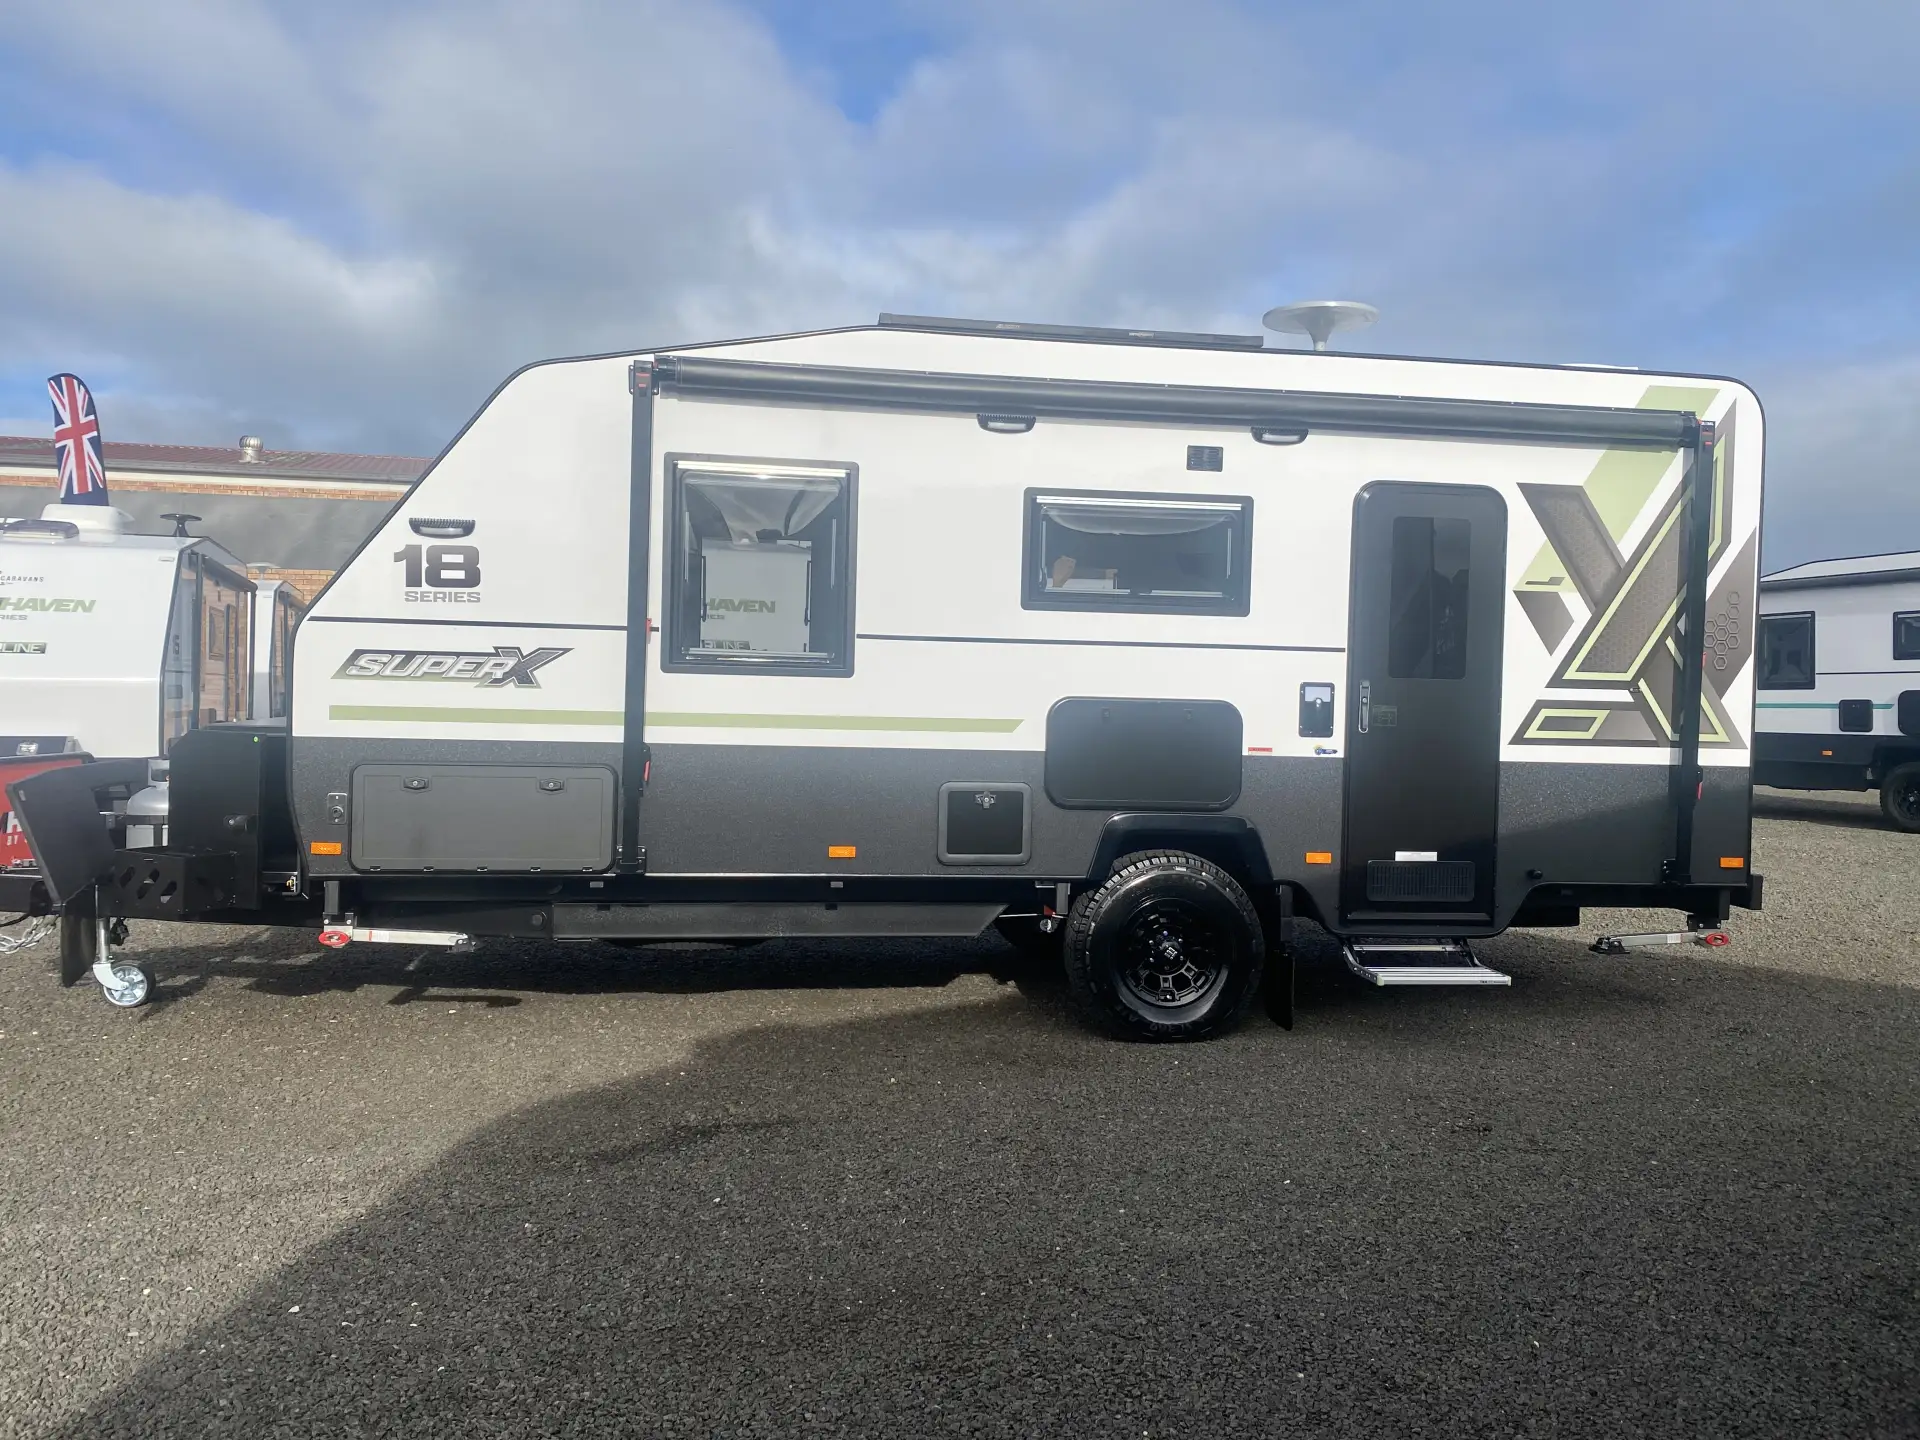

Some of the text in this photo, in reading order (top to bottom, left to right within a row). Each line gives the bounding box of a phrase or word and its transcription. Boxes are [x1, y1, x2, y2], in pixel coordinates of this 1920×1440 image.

[394, 544, 481, 588] 18
[0, 575, 44, 583] CARAVANS
[404, 591, 481, 603] SERIES
[0, 643, 43, 653] LINE
